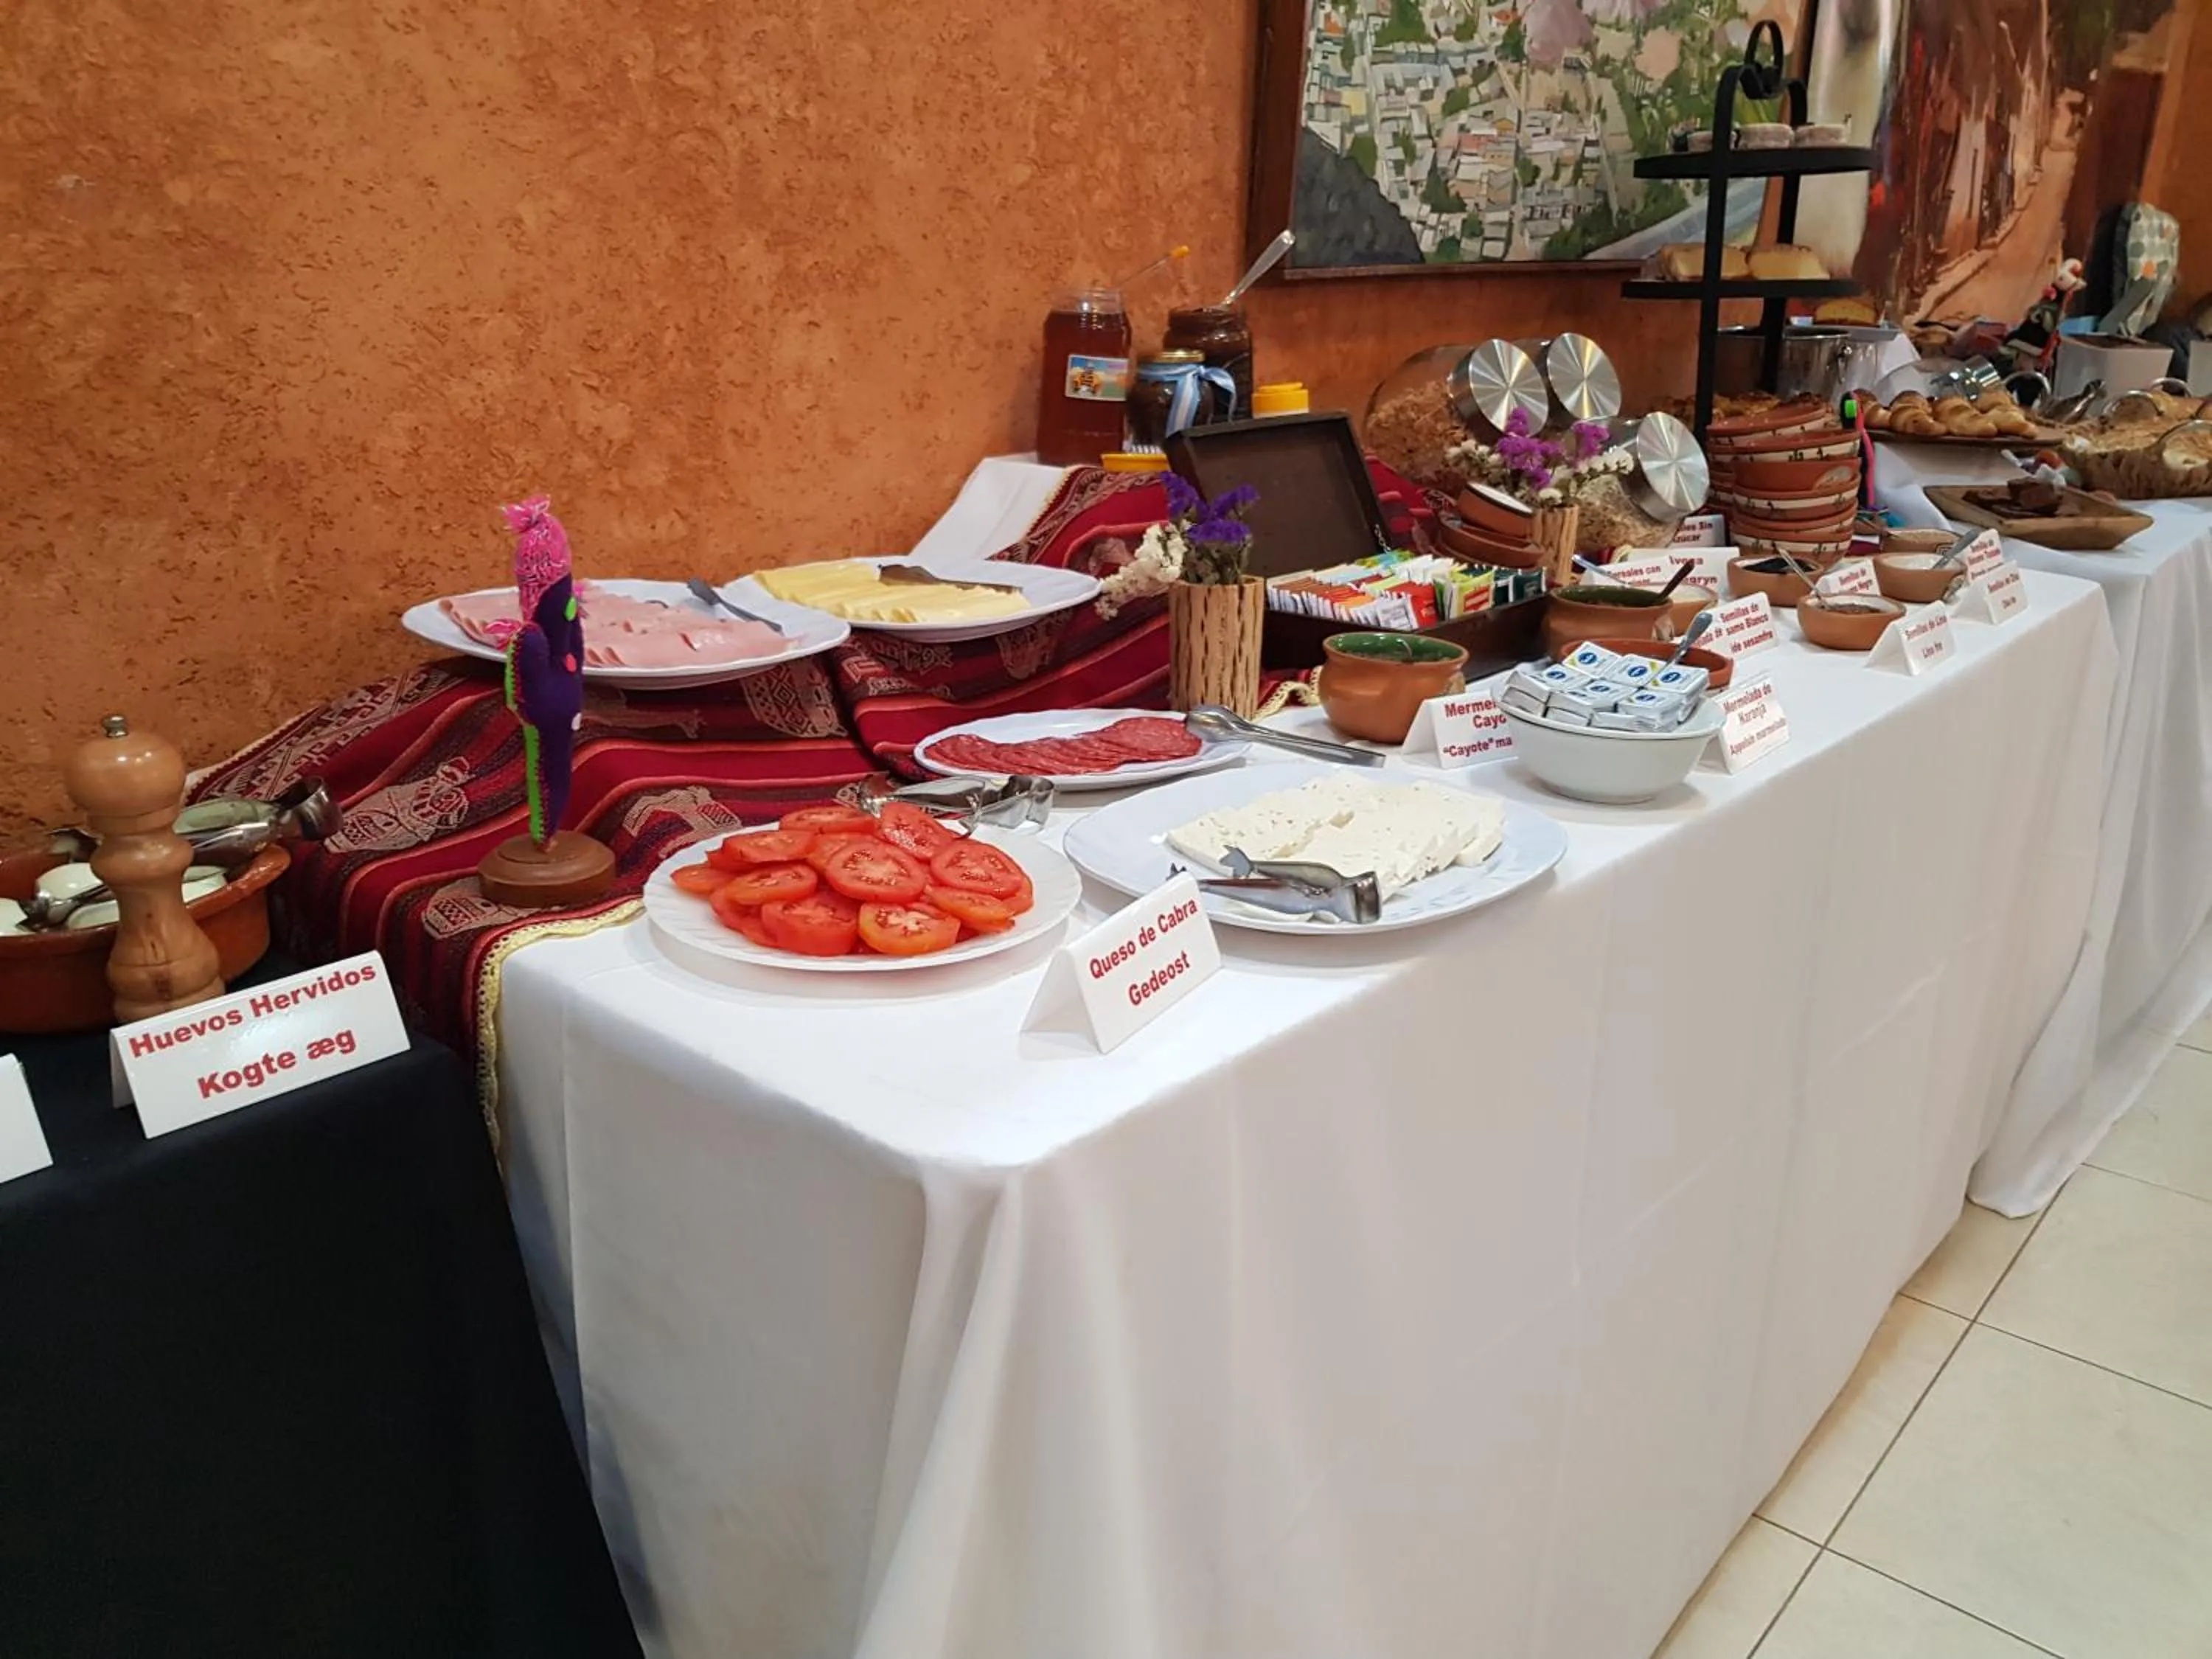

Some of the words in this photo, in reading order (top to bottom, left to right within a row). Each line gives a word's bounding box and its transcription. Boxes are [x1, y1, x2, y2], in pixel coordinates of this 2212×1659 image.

[1750, 602, 1759, 613] de
[1762, 682, 1773, 695] de
[1444, 700, 1496, 718] Mermel
[1472, 713, 1507, 729] Cayo
[1090, 940, 1136, 978] Queso
[1138, 925, 1157, 947] de
[1157, 899, 1198, 933] Cabra
[1128, 950, 1191, 1006] Gedeost
[128, 1007, 243, 1057] Huevos
[249, 964, 377, 1018] Hervidos
[197, 1050, 297, 1099] Kogte
[305, 1029, 357, 1060] æg
